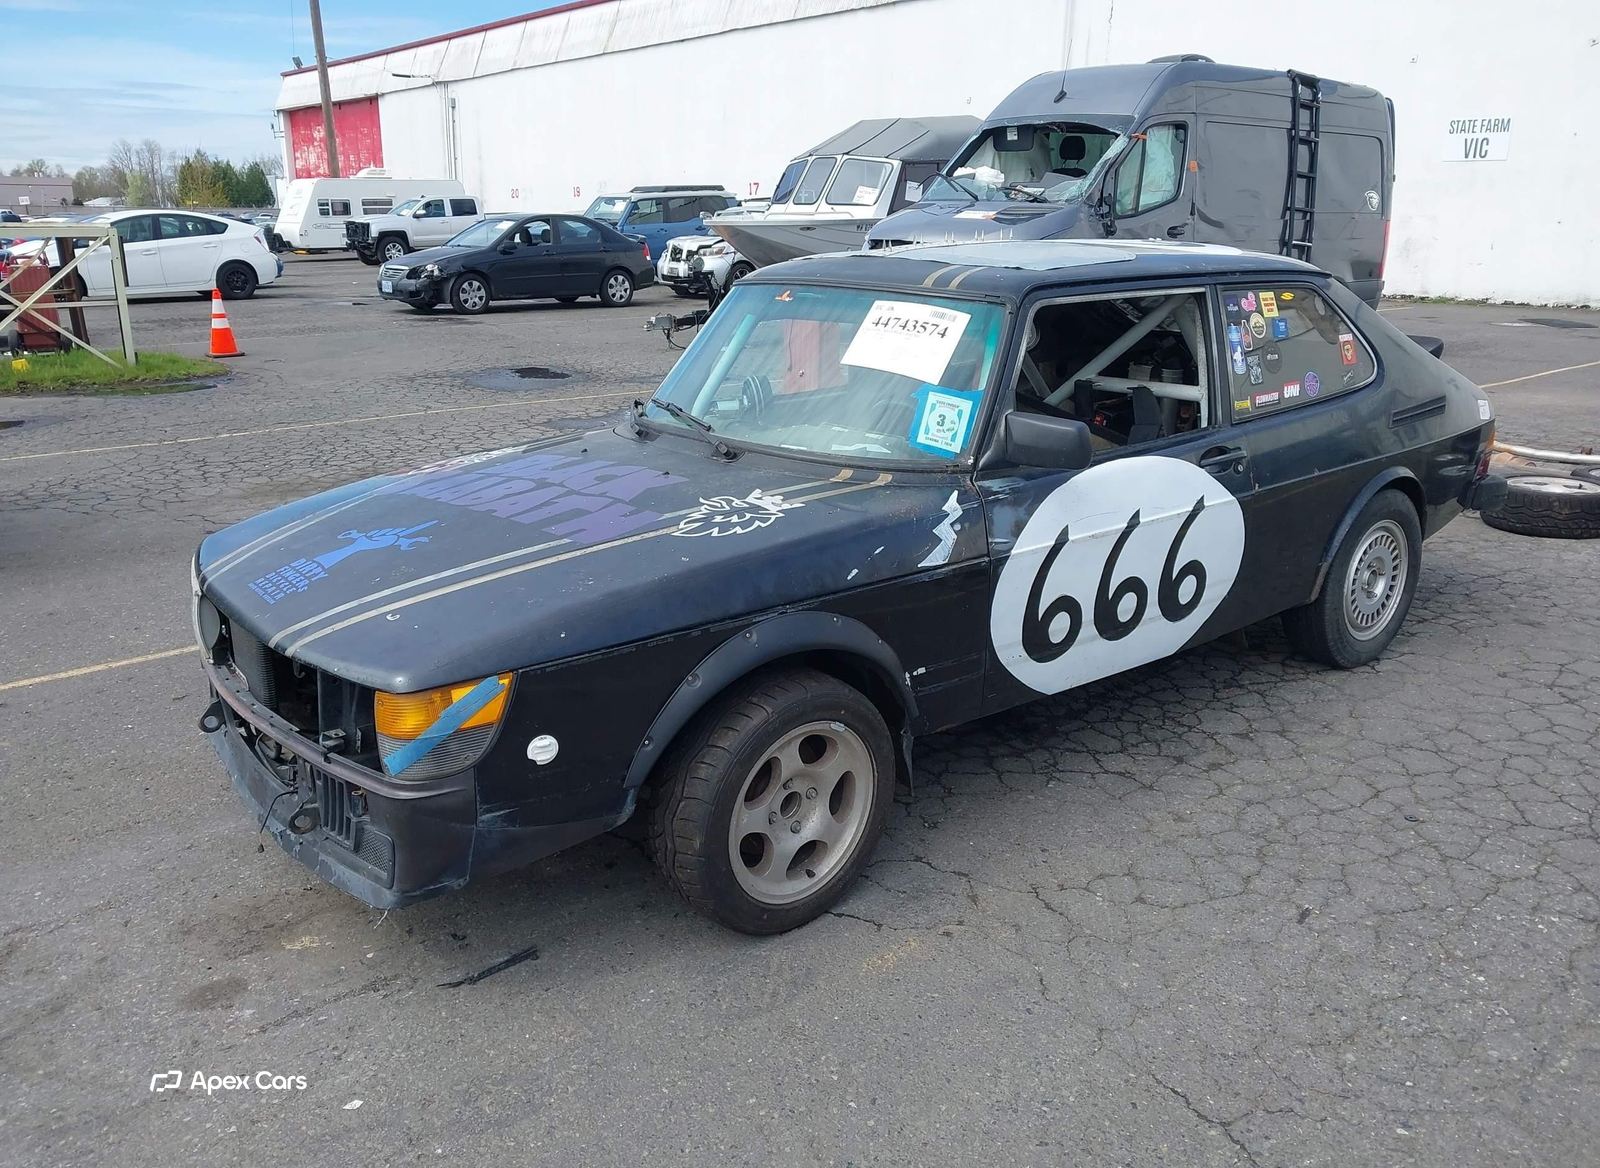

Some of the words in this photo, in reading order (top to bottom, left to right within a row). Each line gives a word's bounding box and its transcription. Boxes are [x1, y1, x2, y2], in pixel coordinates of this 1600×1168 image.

[1449, 119, 1478, 134] STATE
[1480, 118, 1511, 133] FARM
[1464, 137, 1490, 159] VIC
[511, 188, 520, 199] 20
[573, 186, 581, 198] 19
[749, 182, 760, 196] 17
[872, 315, 949, 339] 44743574
[1283, 384, 1300, 398] UNI
[936, 413, 947, 427] 3
[276, 565, 310, 593] FINGERS
[289, 557, 329, 581] DIRTY
[1021, 494, 1208, 664] 666
[254, 577, 285, 600] REPAIR
[265, 571, 297, 594] BICYCLE
